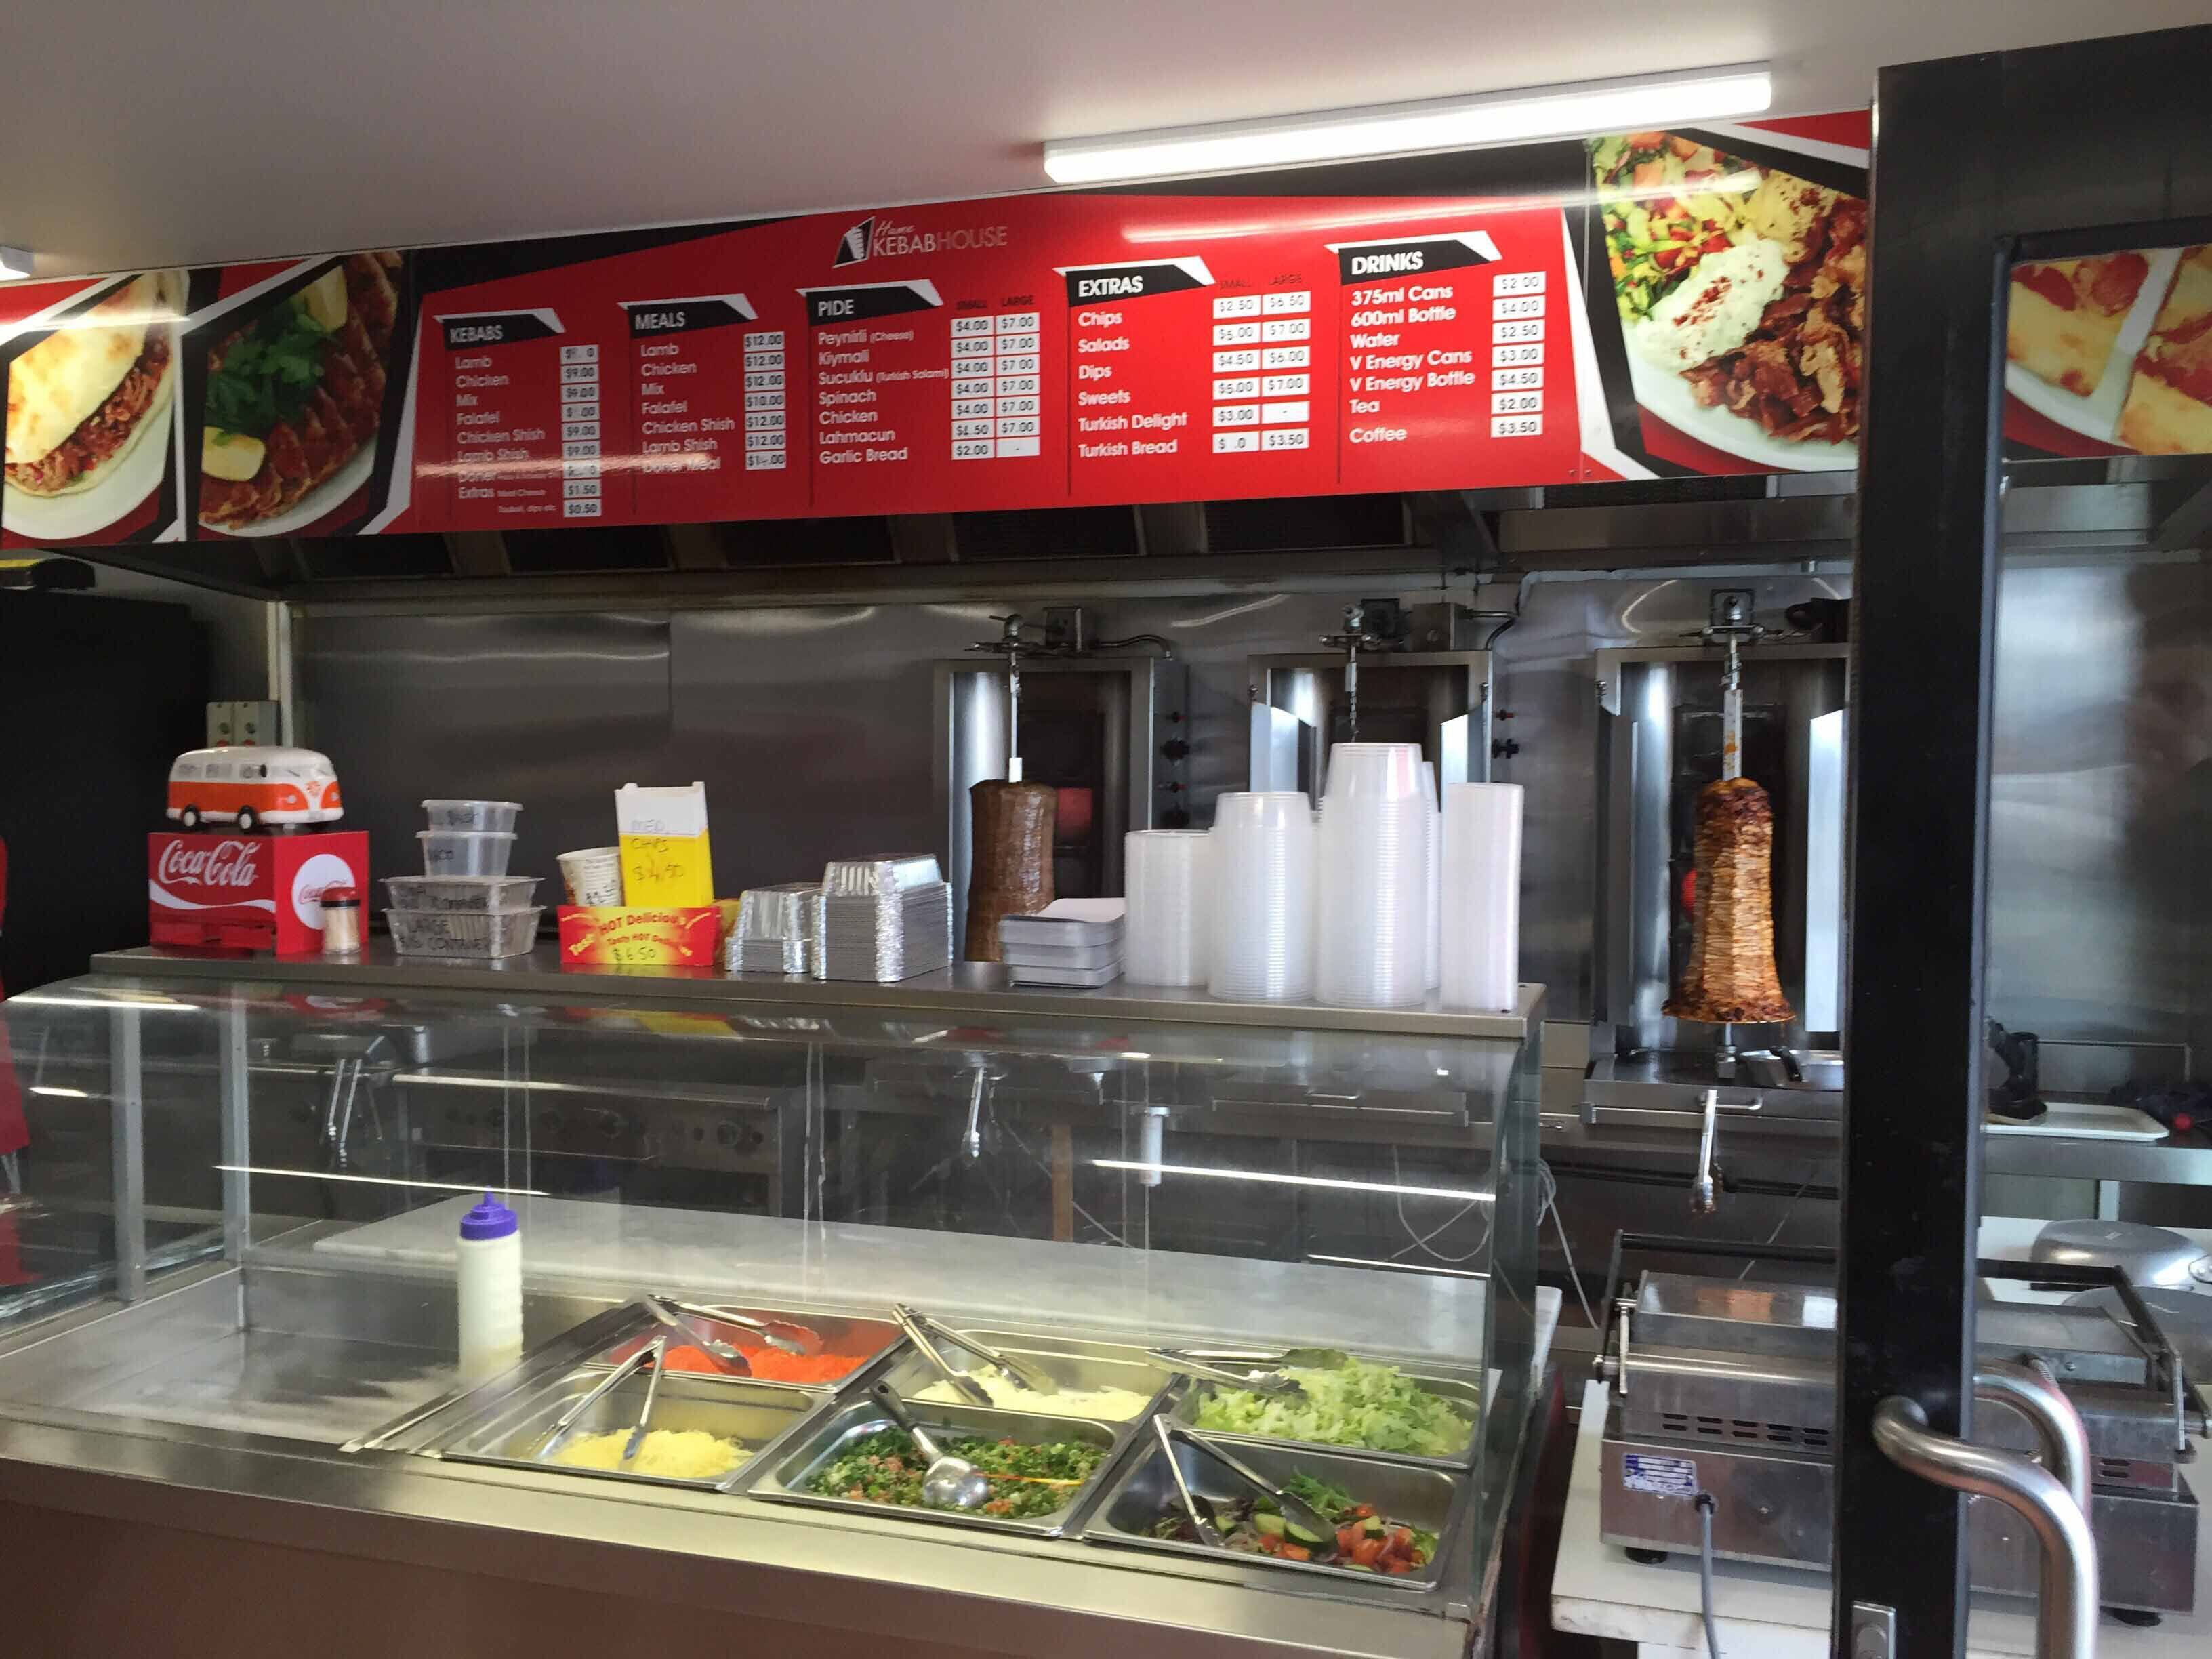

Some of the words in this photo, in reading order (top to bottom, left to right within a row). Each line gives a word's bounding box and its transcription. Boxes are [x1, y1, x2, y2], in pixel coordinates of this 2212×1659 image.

[1351, 251, 1424, 276] DRINKS
[1078, 275, 1144, 297] EXTRAS
[1351, 287, 1405, 306] 375ml
[1408, 285, 1454, 302] Cans
[817, 298, 855, 318] PIDE
[634, 311, 686, 330] MEALS
[956, 320, 989, 332] $4.00
[1002, 316, 1035, 329] $7.00
[1078, 311, 1123, 329] Chips
[1351, 308, 1404, 328] 600ml
[1408, 306, 1456, 323] Bottle
[450, 325, 503, 343] KEBABS
[746, 335, 782, 348] $12.00
[1350, 333, 1401, 349] Water
[640, 342, 680, 357] Lamb
[956, 341, 989, 353] $4.00
[1001, 337, 1035, 350] $7.00
[1078, 336, 1130, 353] Salads
[455, 356, 493, 369] Lamb
[745, 354, 783, 367] $12.00
[1349, 356, 1363, 371] V
[1365, 352, 1424, 371] Energy
[1427, 350, 1473, 366] Cans
[1500, 348, 1538, 362] $3.00
[641, 362, 697, 377] Chicken
[955, 361, 989, 374] $4.00
[1078, 364, 1113, 382] Dips
[455, 374, 510, 388] Chicken
[746, 374, 783, 388] $12.00
[1268, 377, 1304, 390] $7.00
[1349, 377, 1363, 392] V
[1365, 375, 1424, 393] Energy
[1427, 370, 1476, 388] Bottle
[1500, 373, 1539, 386] $4.50
[641, 382, 665, 396] Mix
[956, 382, 989, 395] $4.00
[1002, 380, 1035, 392] $7.00
[455, 394, 477, 407] Mix
[746, 394, 783, 407] $10.00
[819, 388, 877, 407] Spinach
[1078, 390, 1132, 406] Sweets
[1499, 397, 1537, 411] $2.00
[641, 400, 688, 415] Falafel
[956, 403, 989, 417] $4.00
[1002, 401, 1034, 413] $7.00
[1349, 398, 1381, 414] Tea
[457, 411, 500, 424] Falafel
[747, 415, 784, 428] $12.00
[819, 410, 878, 424] Chicken
[1078, 416, 1128, 432] Turkish
[1131, 411, 1187, 432] Delight
[1218, 409, 1253, 422] $3.00
[642, 420, 697, 434] Chicken
[700, 417, 736, 432] Shish
[1002, 422, 1034, 434] $7.00
[1499, 422, 1537, 435] $3.50
[457, 430, 510, 444] Chicken
[512, 428, 546, 441] Shish
[747, 434, 784, 447] $12.00
[819, 430, 896, 445] Lahmacun
[1268, 433, 1304, 447] $3.50
[1349, 426, 1408, 443] Coffee
[642, 440, 681, 453] Lamb
[683, 438, 718, 452] Shish
[956, 445, 989, 457] $2.00
[1078, 442, 1128, 458] Turkish
[1131, 438, 1178, 455] Bread
[457, 450, 494, 462] Lamb
[819, 449, 863, 464] Garlic
[865, 447, 908, 462] Bread
[458, 486, 495, 499] Extras
[158, 840, 262, 887] Coca-Cola
[600, 916, 623, 935] HOT
[626, 912, 687, 926] Delicious
